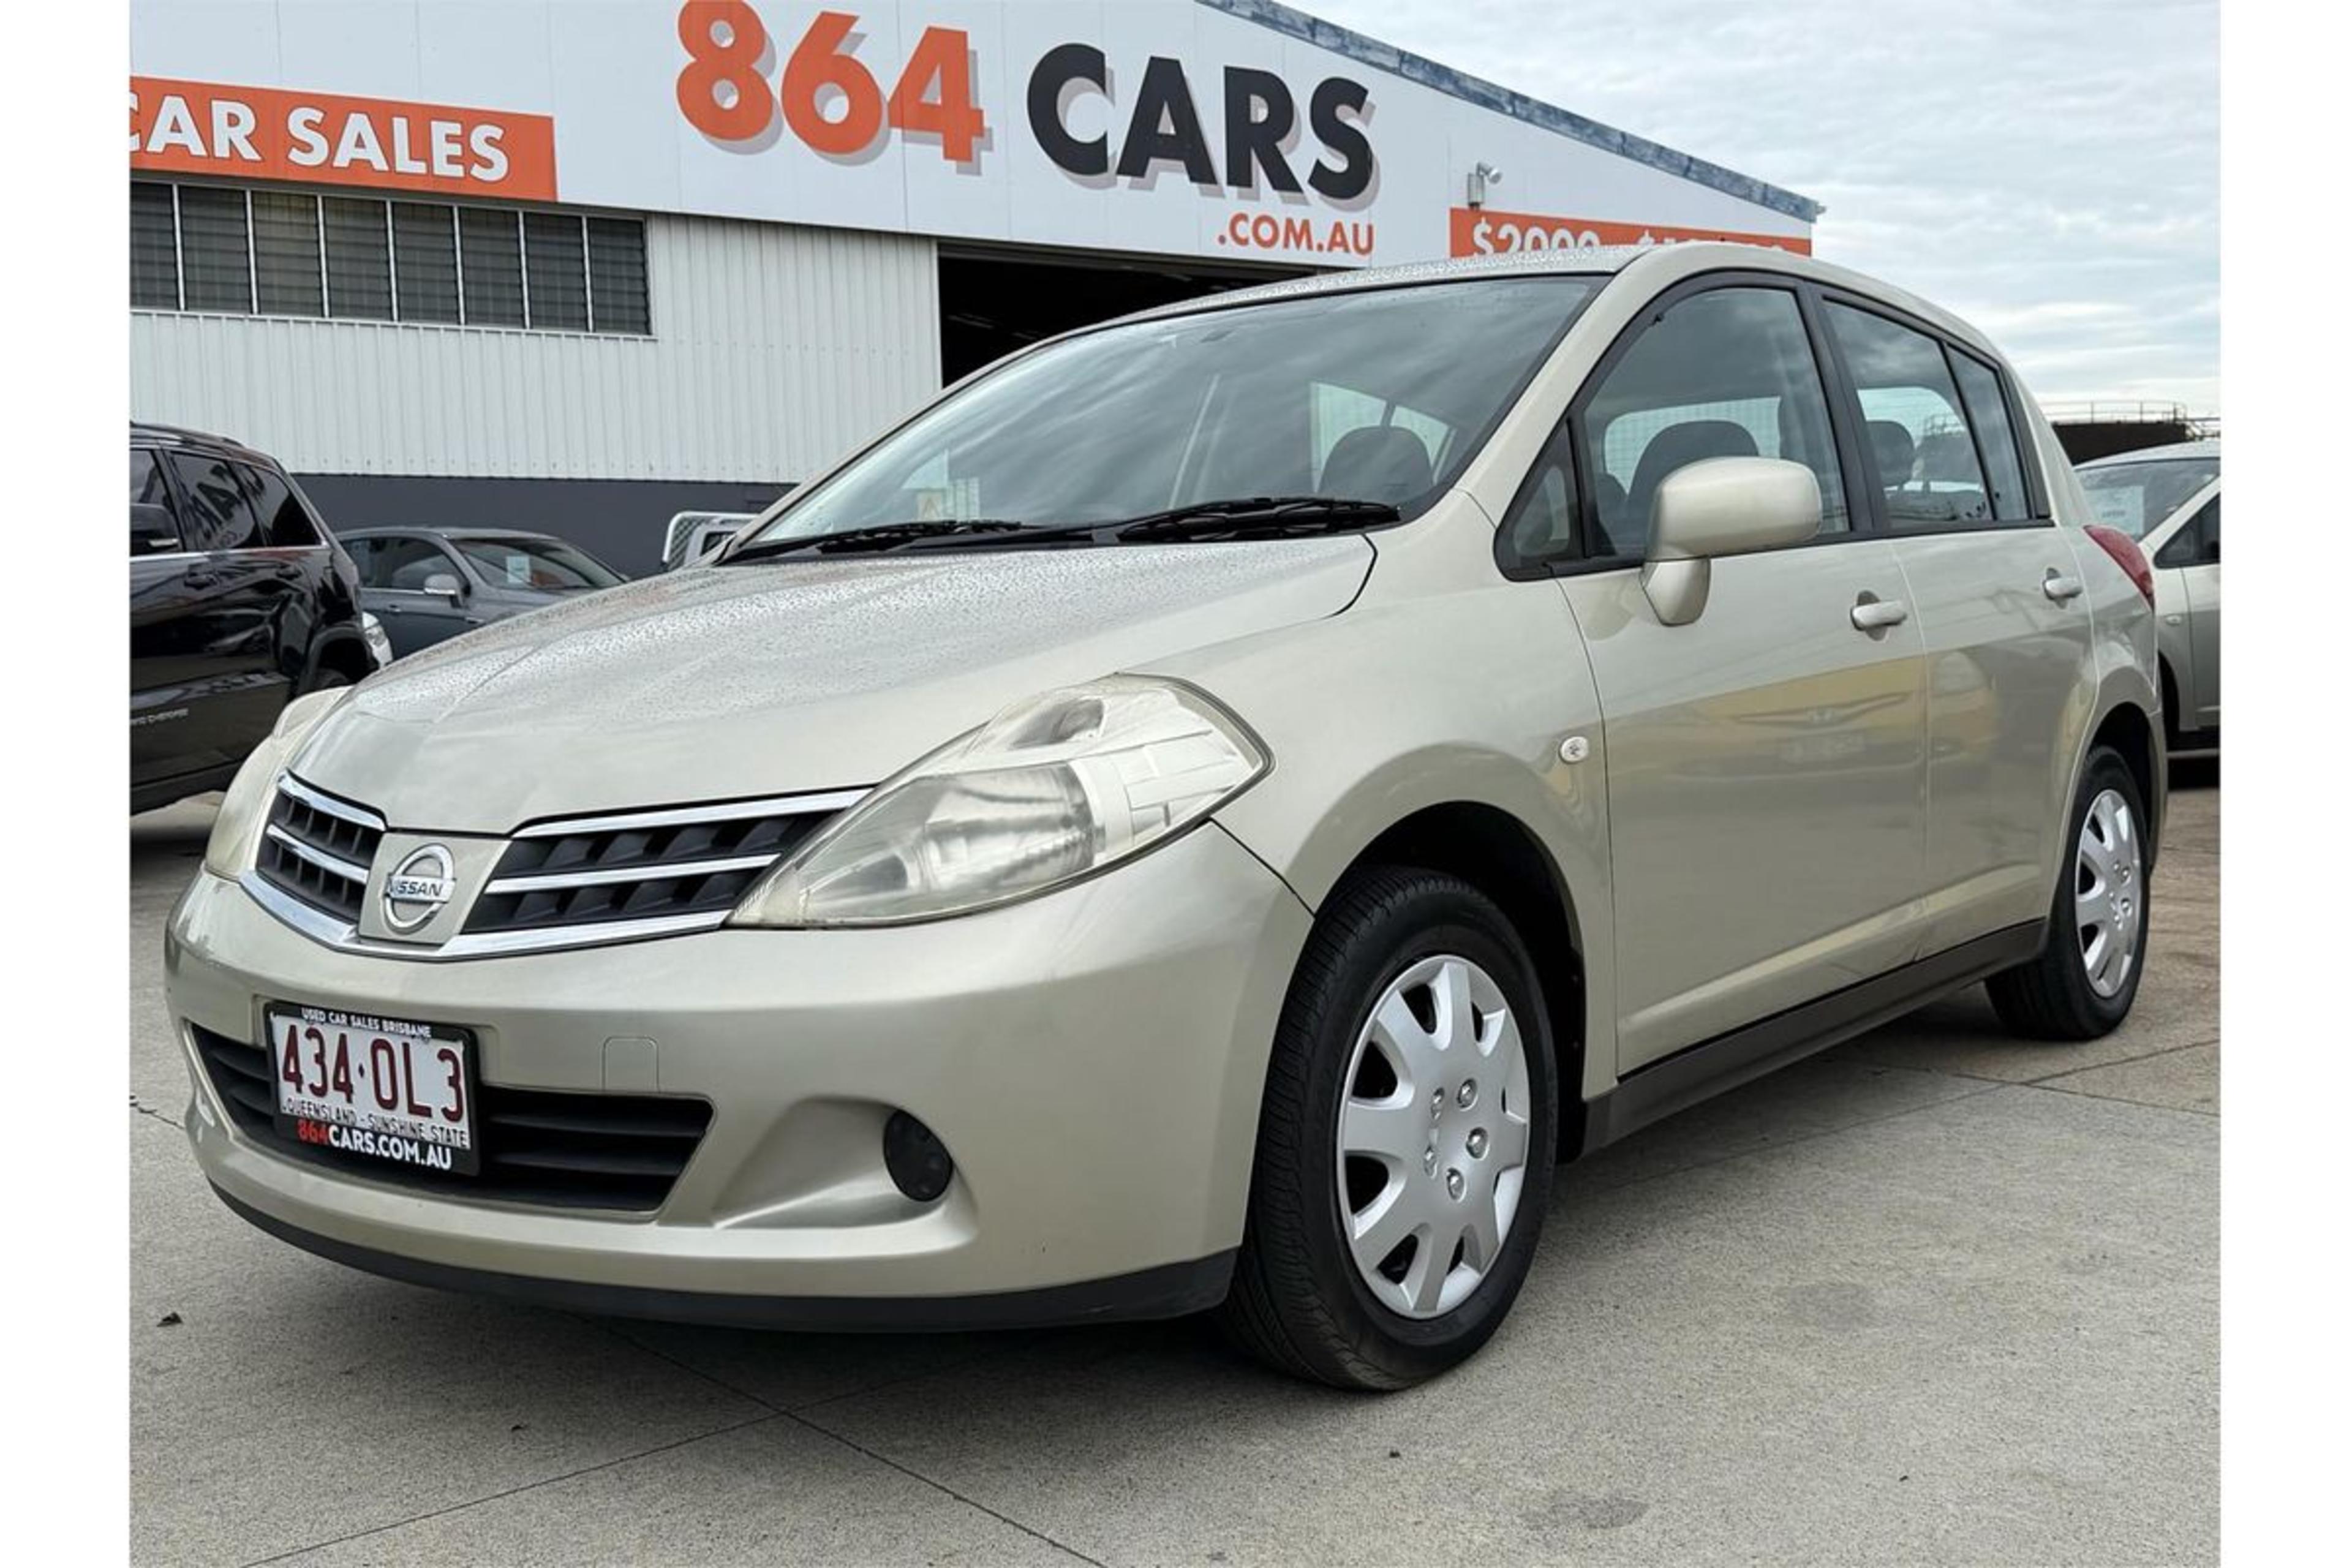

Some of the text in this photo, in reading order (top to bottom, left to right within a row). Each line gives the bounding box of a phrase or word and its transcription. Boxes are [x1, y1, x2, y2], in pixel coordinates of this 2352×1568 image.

[676, 0, 1374, 201] 864 CARS
[130, 91, 509, 182] AR SALES
[1218, 212, 1374, 255] .COM.AU
[301, 1007, 432, 1038] USED CAR SALES BRISBANE
[297, 1118, 452, 1170] 864CARS.COM.AU
[430, 1125, 469, 1148] STATE
